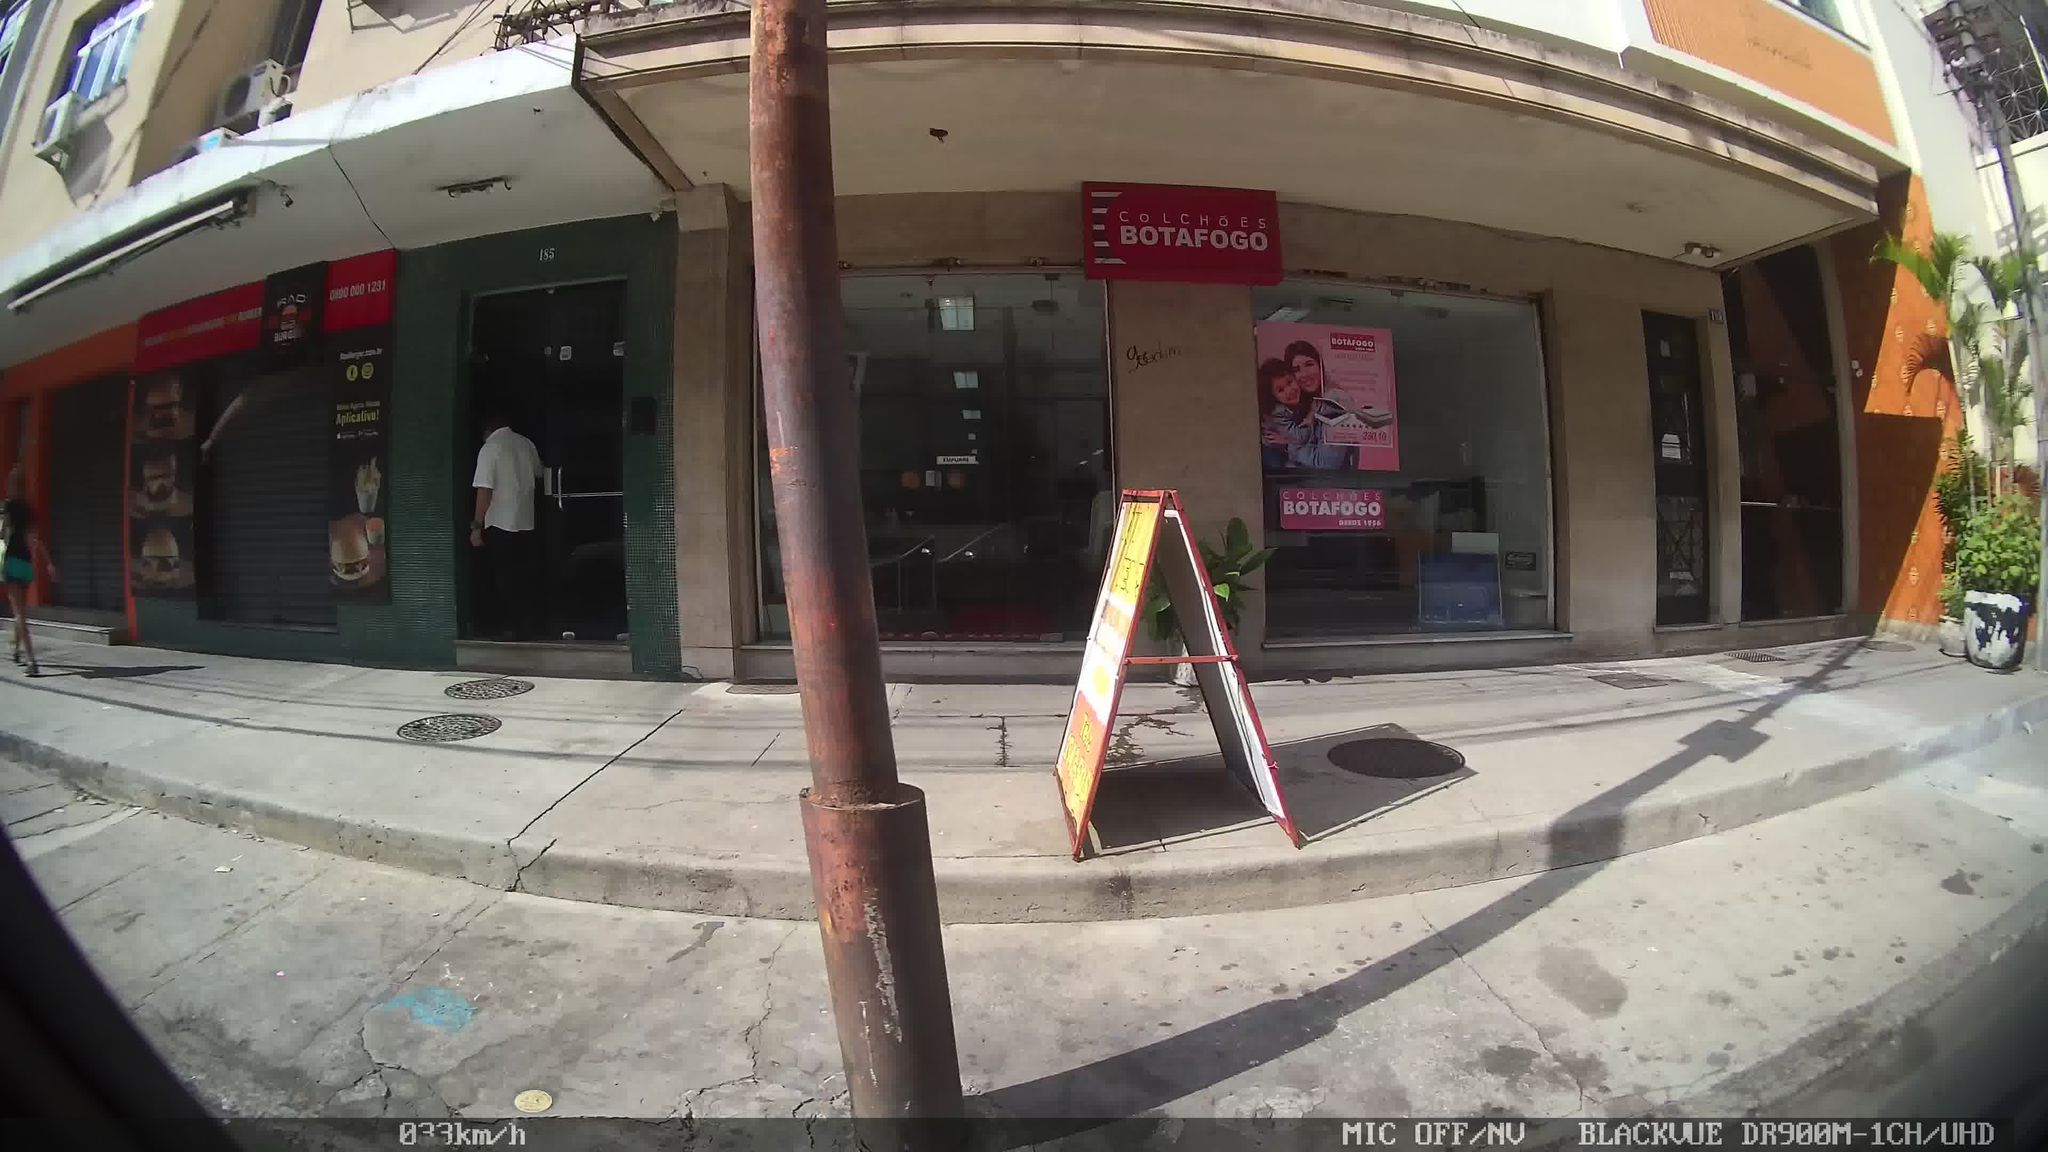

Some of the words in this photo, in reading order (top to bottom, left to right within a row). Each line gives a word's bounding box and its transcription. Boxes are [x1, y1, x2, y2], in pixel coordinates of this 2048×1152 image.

[1119, 211, 1267, 229] COLCHÕES
[1120, 225, 1269, 251] BOTAFOGO
[1331, 337, 1375, 348] BOTAFOGO
[1283, 501, 1381, 517] BOTAFOGO
